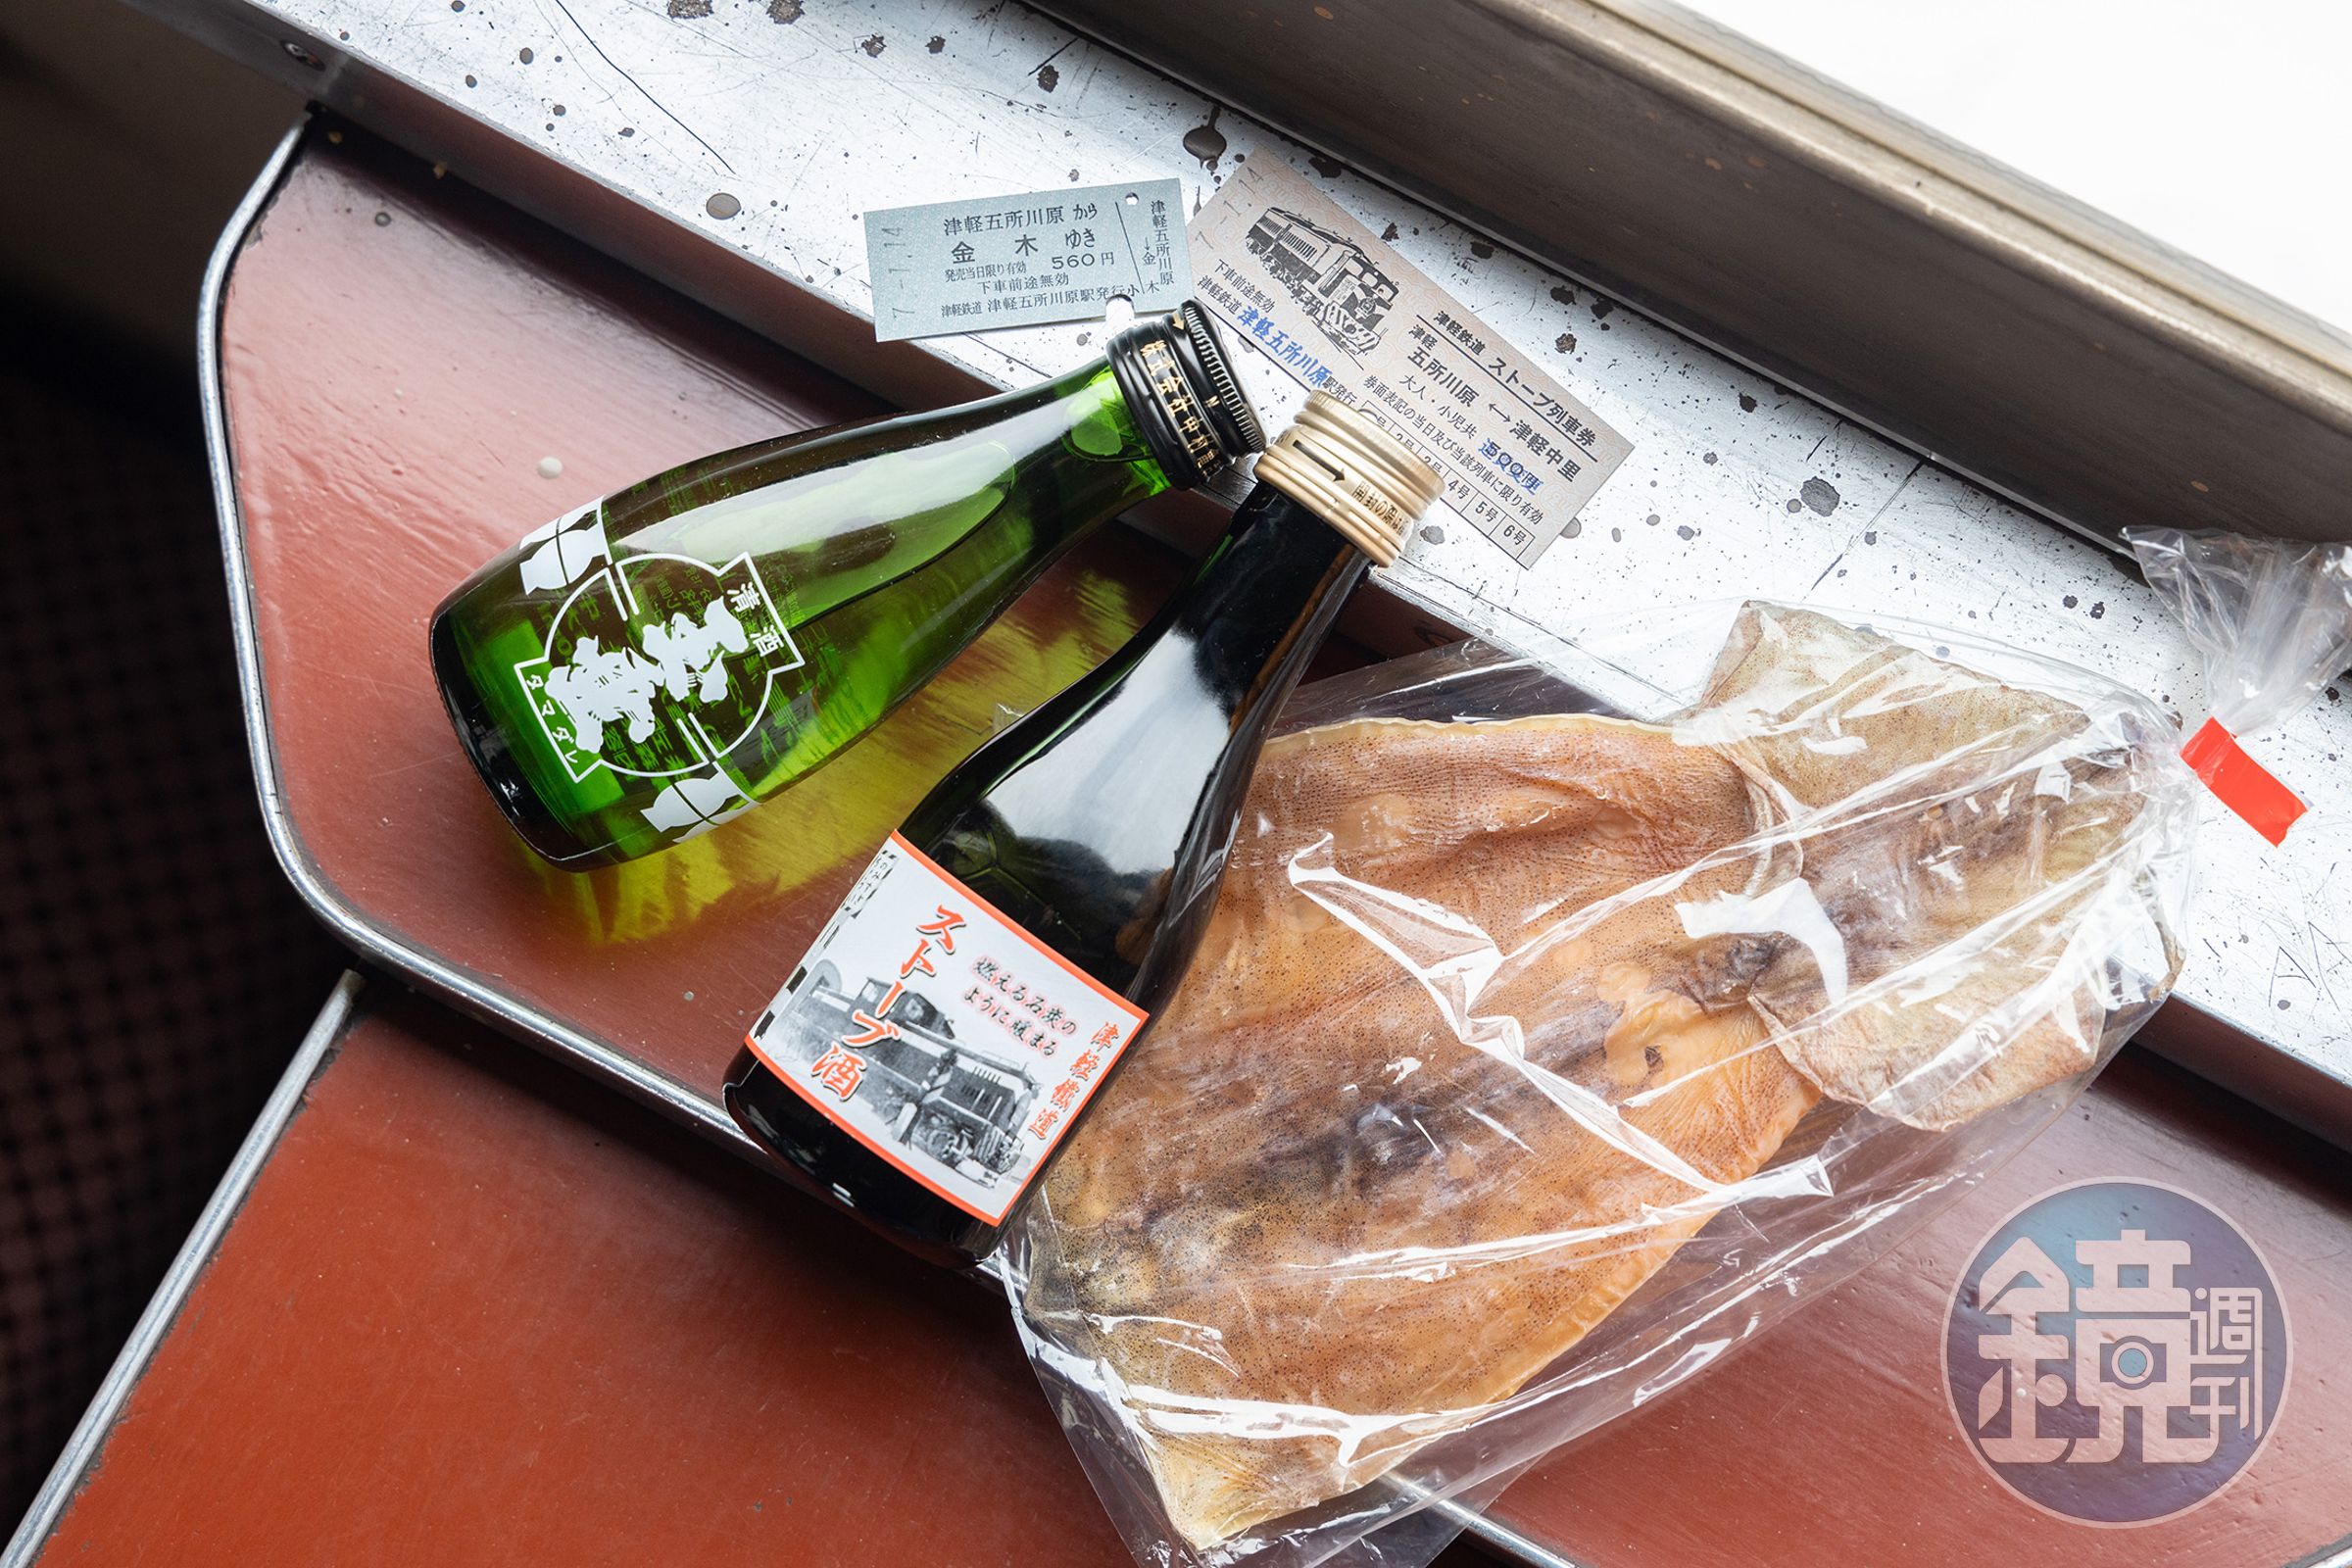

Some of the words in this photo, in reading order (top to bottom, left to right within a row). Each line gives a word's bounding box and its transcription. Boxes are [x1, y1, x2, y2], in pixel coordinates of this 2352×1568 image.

[944, 205, 1064, 236] 津軽五所川原
[1073, 203, 1098, 221] から
[1064, 227, 1096, 250] ゆき
[1151, 200, 1174, 286] 津軽五所川原
[945, 261, 1027, 282] 発売当日限り有効
[981, 272, 1070, 294] 下車前途無効
[1198, 275, 1242, 316] 津軽鉄道
[1214, 259, 1275, 314] 下車前途無効
[941, 301, 982, 318] 津軽鉄道
[1408, 323, 1439, 350] 津軽
[1433, 310, 1486, 356] 津軽鉄道
[1488, 357, 1597, 448] ストーブ列車券
[1407, 346, 1480, 408] 五所川原
[1509, 419, 1582, 482] 津軽中里
[1363, 374, 1544, 525] 券面表記の当日及び当該列車に限り有効
[1447, 478, 1471, 501] 4号
[1474, 500, 1499, 523] 5号
[1503, 522, 1527, 547] 6号
[727, 581, 784, 659] 清酒
[525, 673, 579, 764] タマダレ
[810, 903, 967, 1103] ストーブ酒
[973, 956, 1078, 1036] 燃える石炭の
[963, 988, 1057, 1057] ように暖まる
